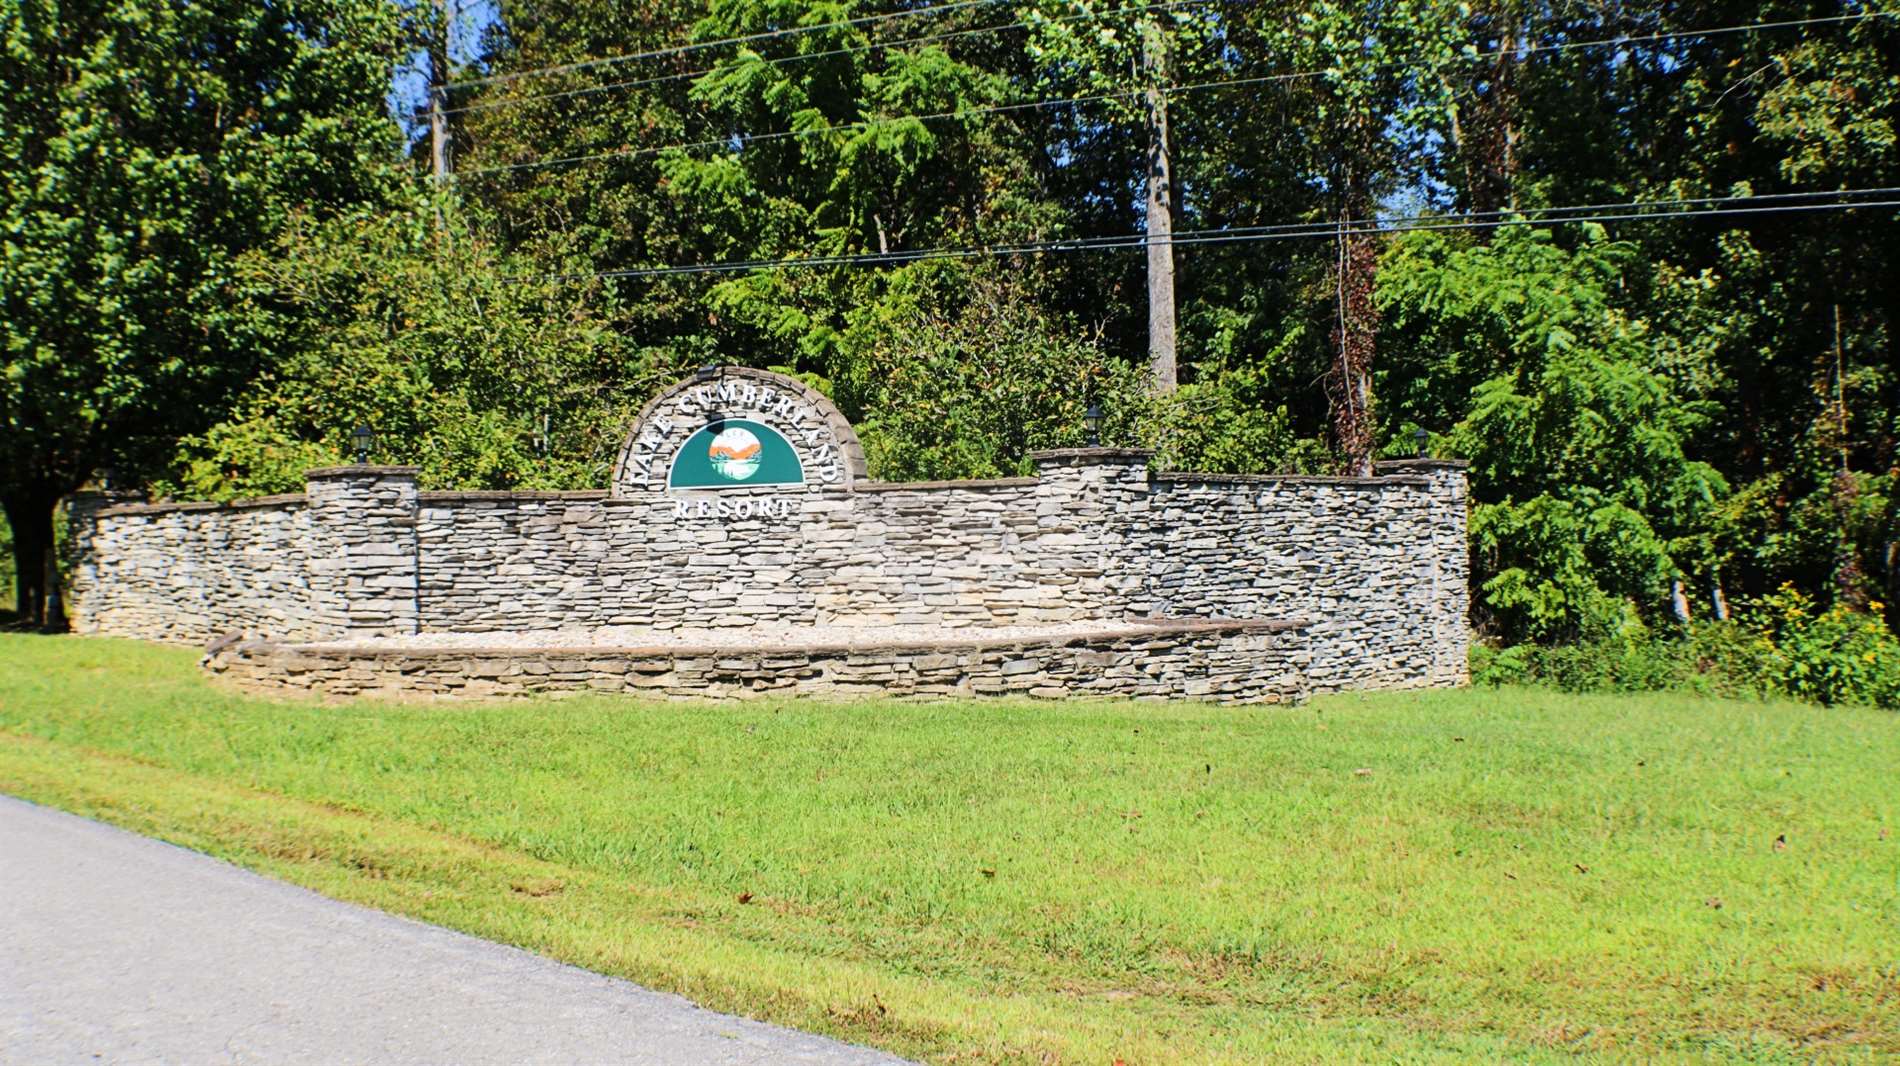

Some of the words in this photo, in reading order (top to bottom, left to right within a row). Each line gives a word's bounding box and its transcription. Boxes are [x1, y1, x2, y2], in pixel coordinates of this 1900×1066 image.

[630, 415, 673, 485] LAKE
[679, 383, 839, 482] CUMBERLAND
[674, 498, 793, 519] RESORT
